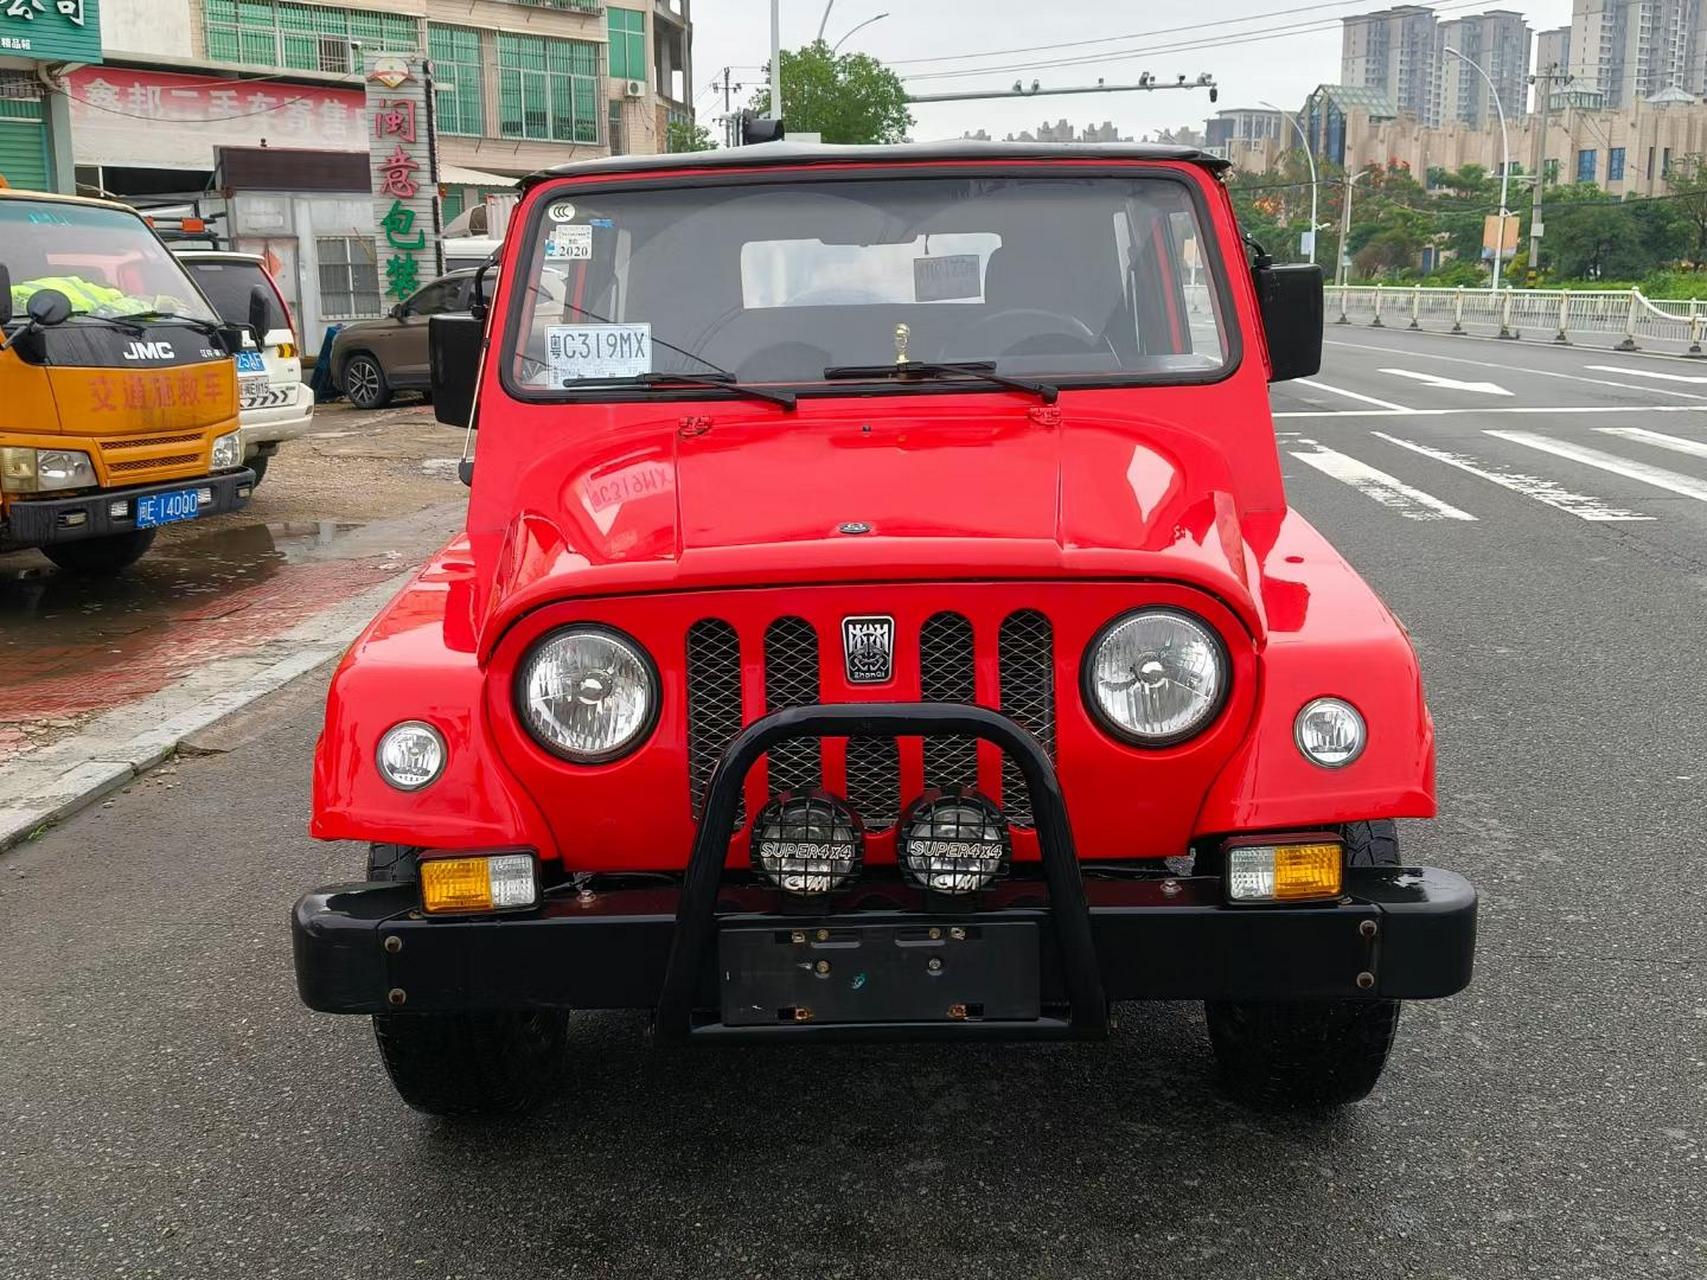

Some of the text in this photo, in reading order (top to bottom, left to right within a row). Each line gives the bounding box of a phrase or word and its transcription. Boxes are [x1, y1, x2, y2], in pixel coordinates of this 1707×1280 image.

[374, 98, 426, 301] 闽意包装
[560, 246, 588, 257] 2020
[123, 342, 174, 359] JMC
[550, 332, 645, 359] 粤C319MX
